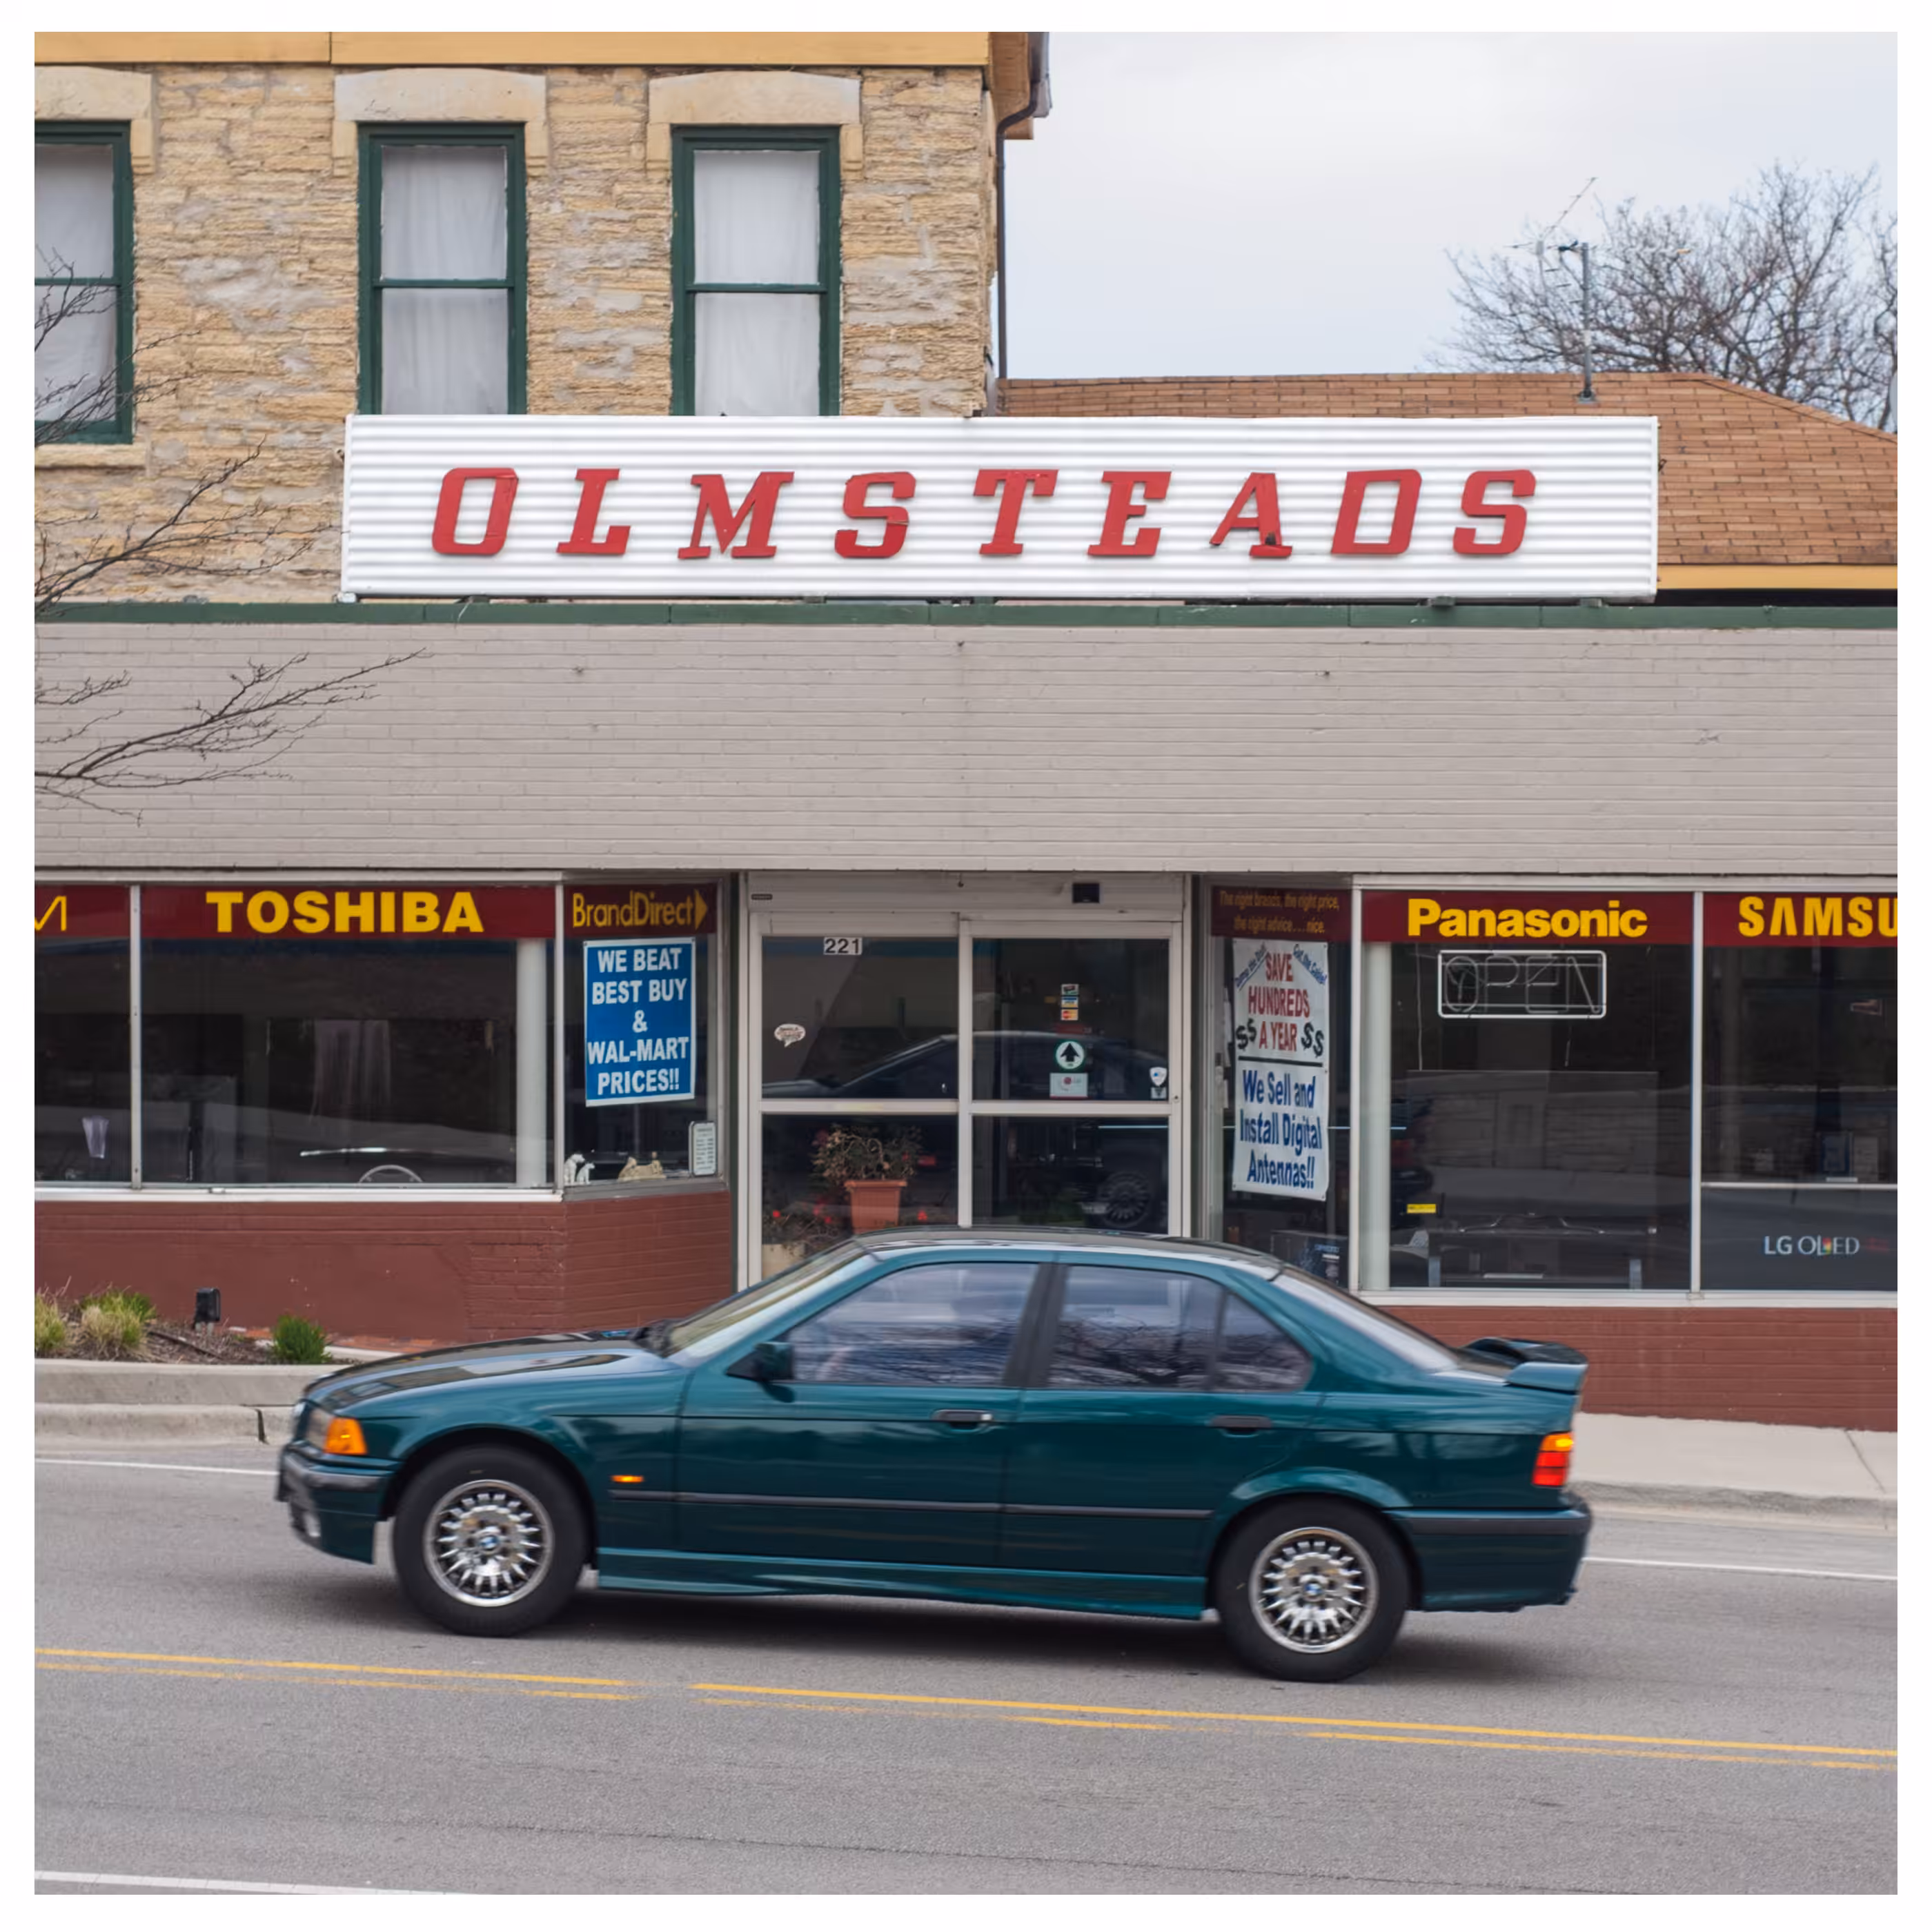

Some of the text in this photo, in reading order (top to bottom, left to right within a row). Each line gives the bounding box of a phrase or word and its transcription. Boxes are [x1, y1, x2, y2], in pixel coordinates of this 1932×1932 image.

[432, 467, 1537, 560] OLMSTEADS
[206, 891, 484, 934] TOSHIBA
[573, 889, 693, 927] BrandDirect
[1408, 898, 1648, 938] Panasonic
[1738, 896, 1897, 937] SAMSU
[598, 947, 682, 973] WE BEAT
[825, 938, 858, 954] 221
[1265, 952, 1294, 982] SAVE
[592, 978, 687, 1005] BEST BUY
[1445, 956, 1602, 1013] OPEN
[1248, 985, 1310, 1018] HUNDREDS
[632, 1009, 648, 1033] &
[1259, 1021, 1268, 1049] A
[1270, 1022, 1297, 1052] YEAR
[587, 1036, 689, 1065] WAL-MART
[598, 1067, 680, 1095] PRICES!!
[1243, 1070, 1316, 1109] We Sell and
[1240, 1108, 1322, 1156] Install Digital
[1246, 1148, 1315, 1189] Antennas!!
[1764, 1236, 1793, 1254] LG
[1797, 1235, 1860, 1256] OLED
